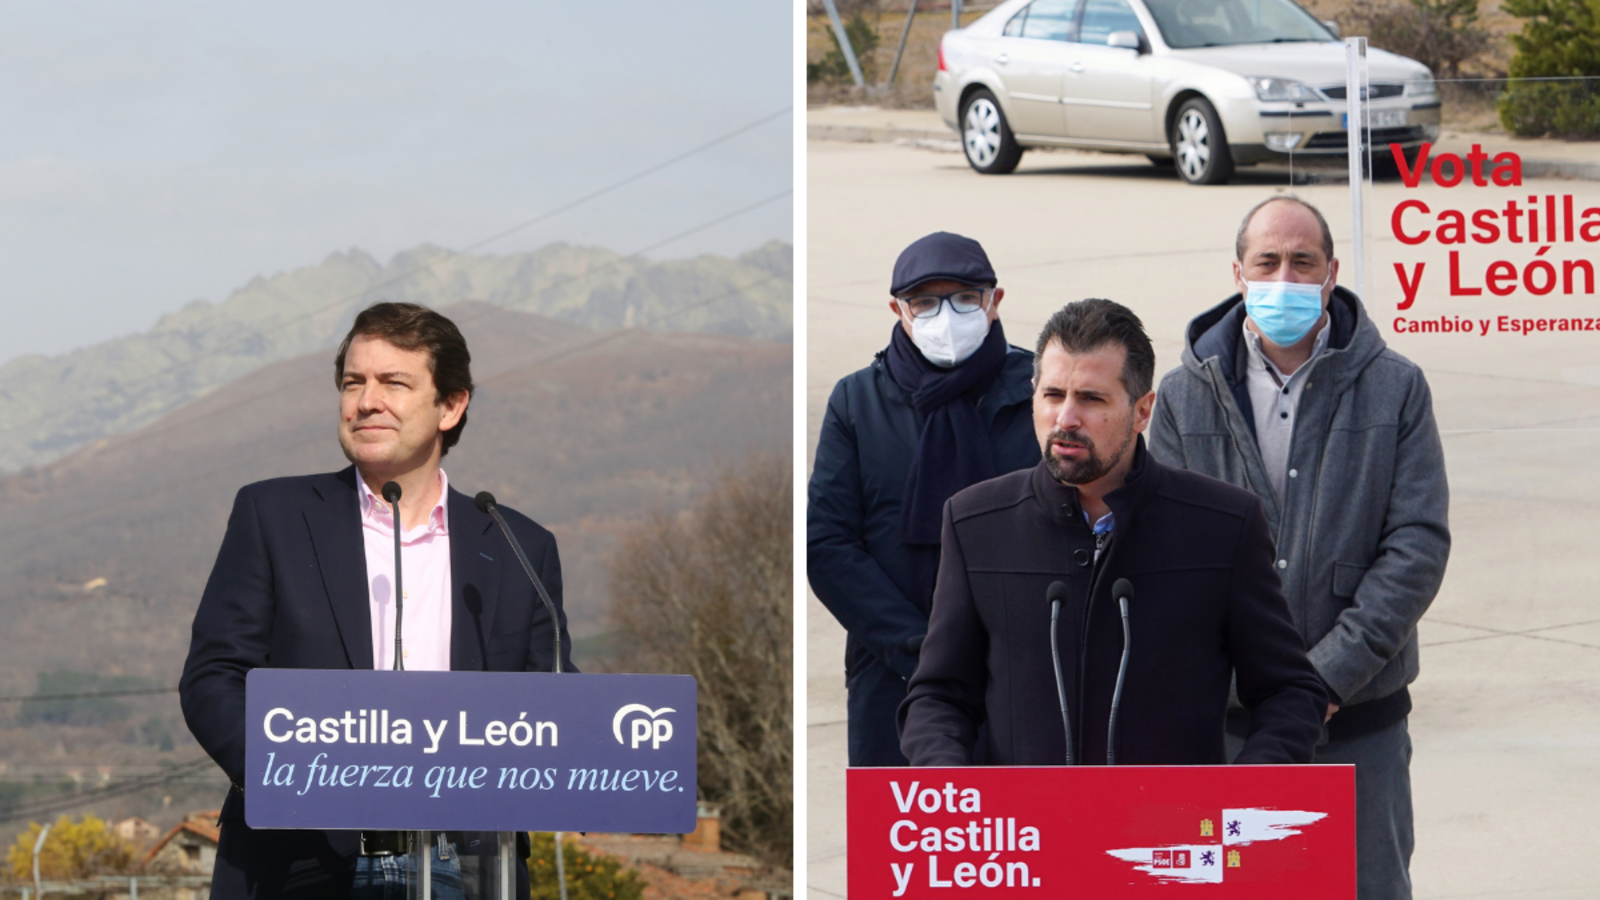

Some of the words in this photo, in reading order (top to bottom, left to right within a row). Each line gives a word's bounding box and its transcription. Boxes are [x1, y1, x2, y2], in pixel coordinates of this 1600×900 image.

[1389, 142, 1523, 188] Vota
[1391, 194, 1600, 246] Castilla
[1393, 262, 1426, 311] y
[1449, 246, 1595, 297] León
[1393, 315, 1474, 333] Cambio
[1479, 319, 1491, 337] y
[263, 707, 413, 745] Castilla
[422, 719, 449, 754] y
[458, 710, 559, 747] León
[262, 752, 296, 787] la
[297, 752, 414, 796] fuerza
[423, 765, 488, 798] que
[496, 767, 558, 791] nos
[567, 768, 685, 793] mueve.
[889, 781, 981, 814] Vota
[889, 817, 1041, 853] Castilla
[890, 862, 914, 897] y
[928, 852, 1041, 888] León.
